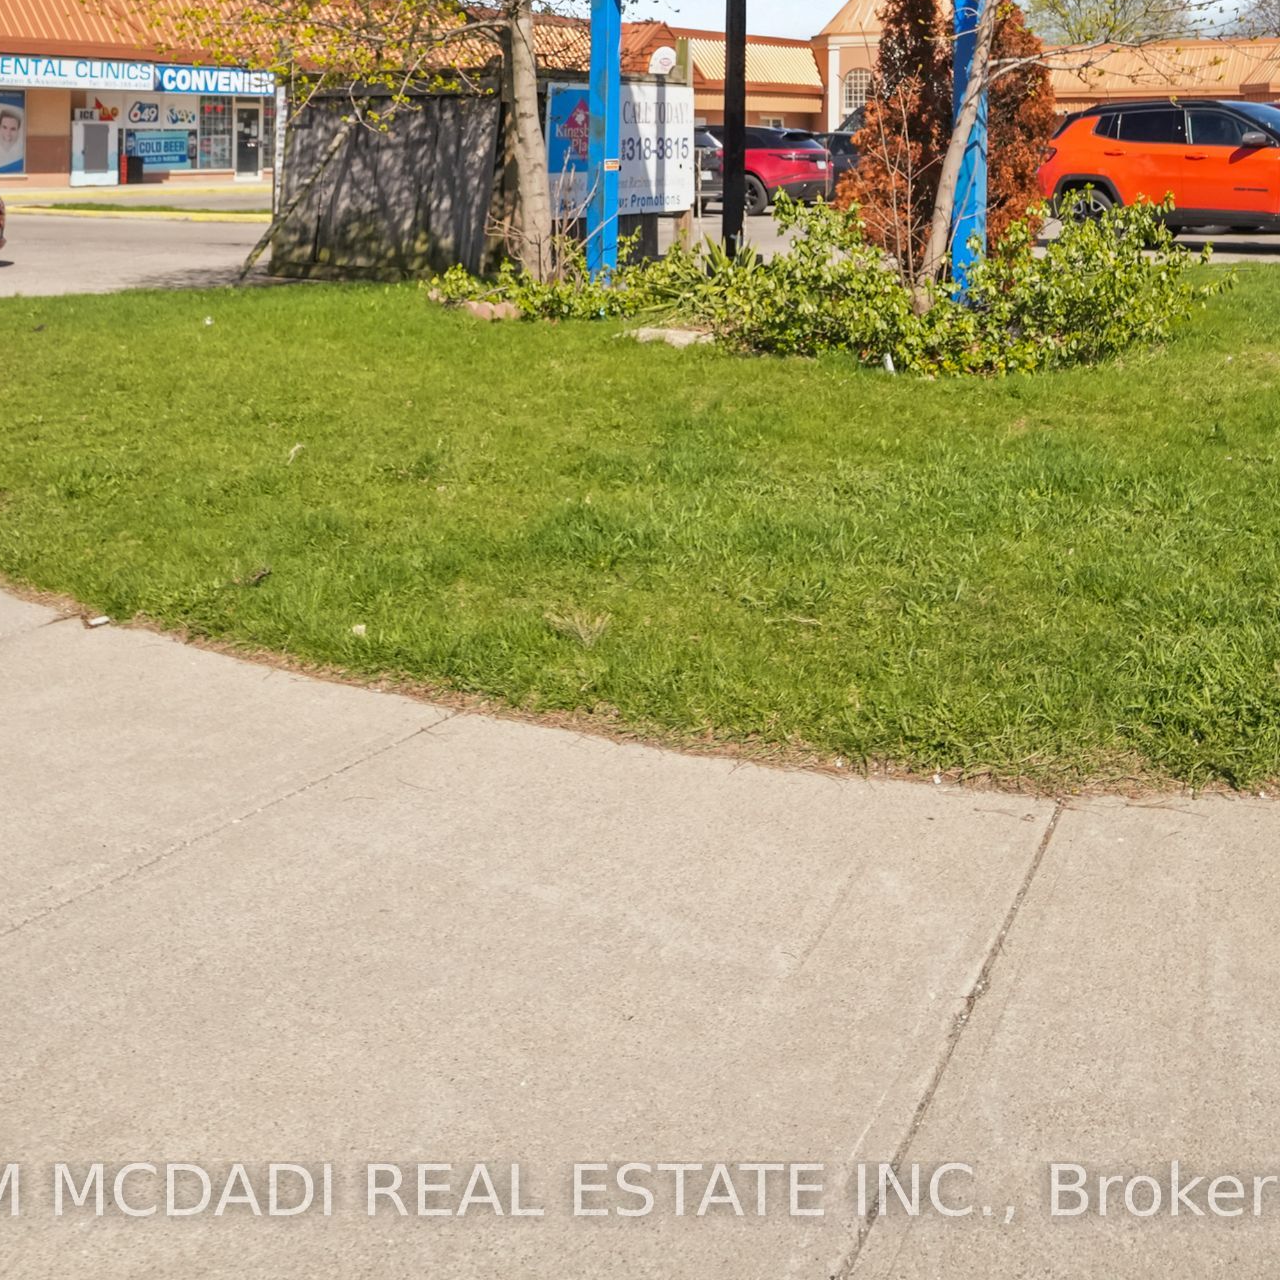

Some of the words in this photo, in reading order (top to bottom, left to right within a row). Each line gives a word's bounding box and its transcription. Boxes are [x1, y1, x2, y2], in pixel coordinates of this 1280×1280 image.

[75, 60, 151, 81] CLINICS
[163, 68, 275, 93] CONVENIEN
[80, 110, 94, 120] ICE
[623, 100, 651, 125] CALL
[555, 122, 589, 139] Kingsb
[140, 141, 161, 154] COLD
[163, 140, 185, 153] BEER
[572, 138, 588, 154] Pla
